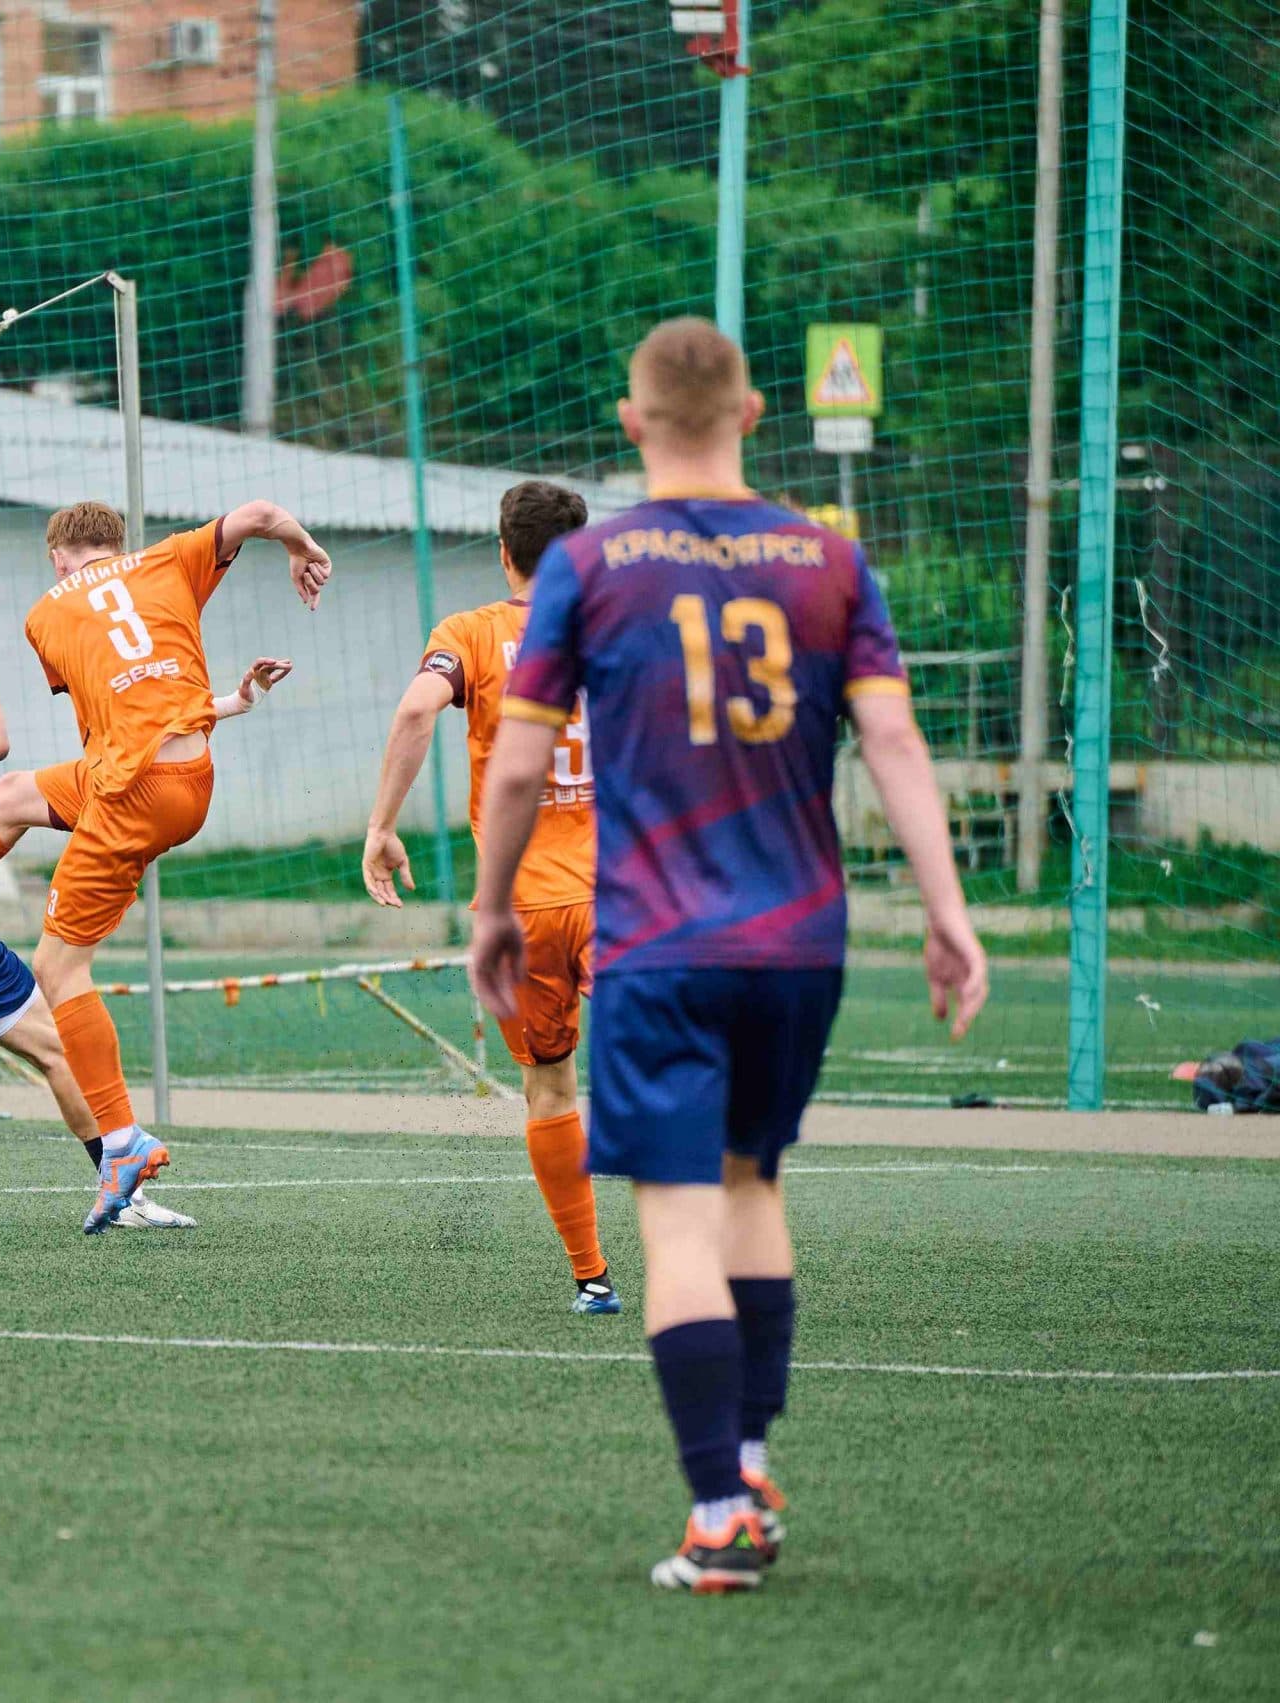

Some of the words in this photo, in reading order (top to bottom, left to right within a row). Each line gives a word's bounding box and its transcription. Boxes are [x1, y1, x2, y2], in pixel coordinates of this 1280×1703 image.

[602, 527, 825, 571] КРАСНОЯРСК
[87, 578, 154, 661] 3
[670, 594, 797, 745] 13
[47, 888, 59, 917] 3
